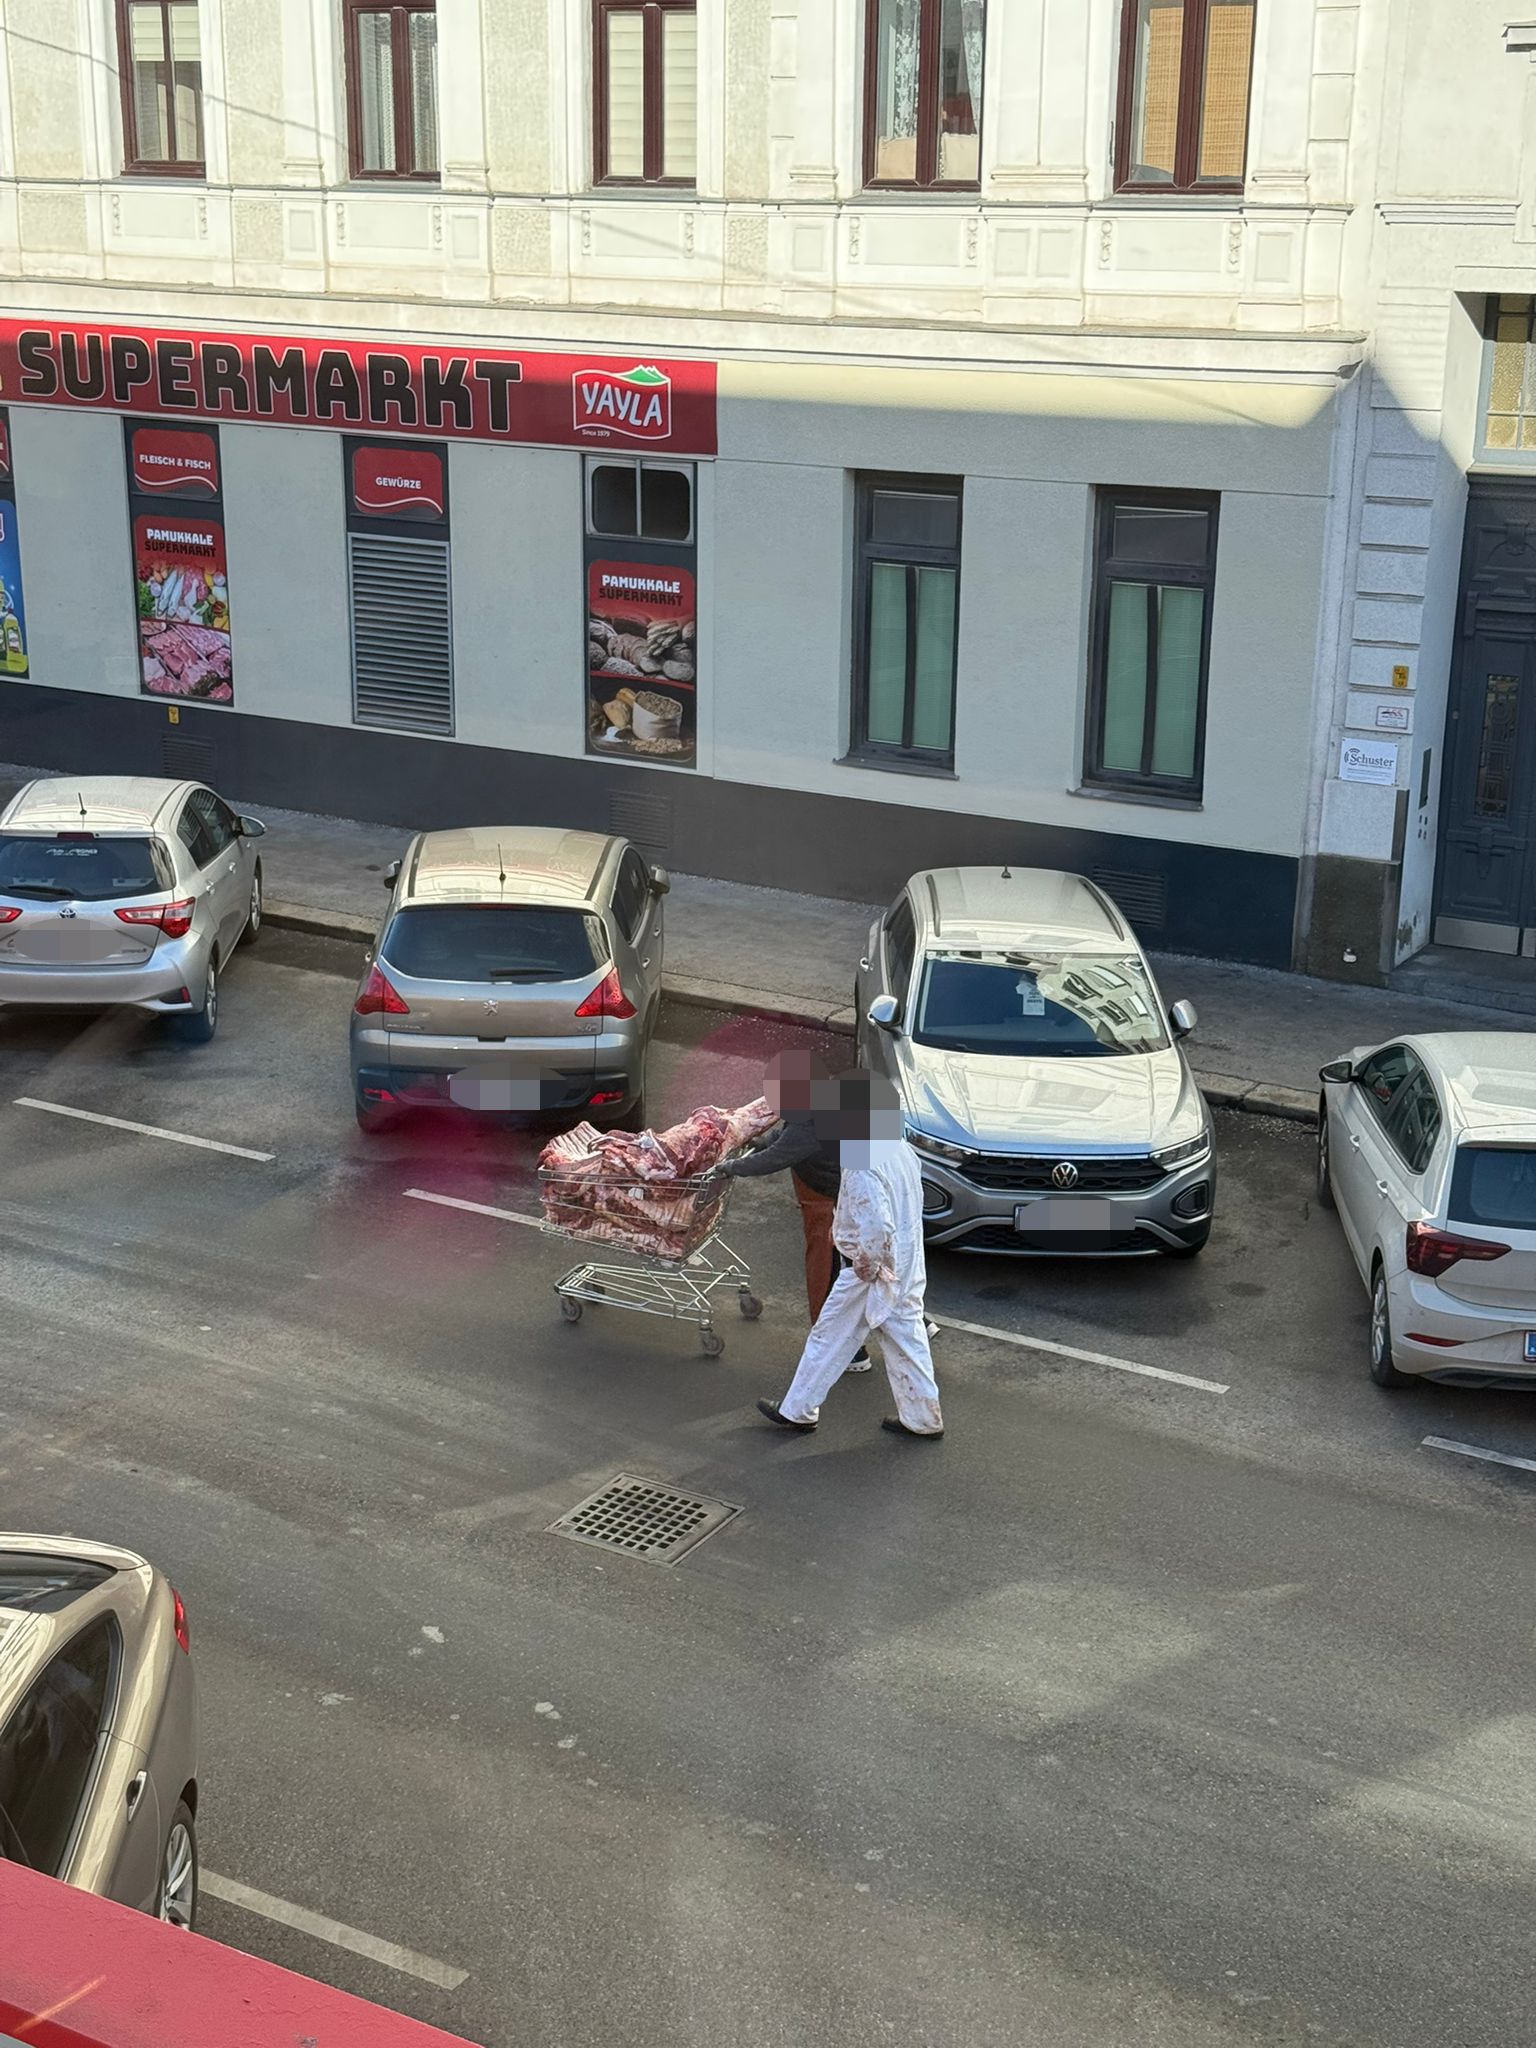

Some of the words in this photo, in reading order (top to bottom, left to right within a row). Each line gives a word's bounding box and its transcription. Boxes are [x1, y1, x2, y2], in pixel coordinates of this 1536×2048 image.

[18, 329, 523, 433] SUPERMARKT
[582, 381, 663, 427] YAYLA
[139, 454, 175, 466] FLEISCH
[176, 458, 183, 467] &
[185, 459, 212, 470] FISCH
[375, 476, 422, 490] GEWÜRZE
[146, 528, 214, 545] PAMUKKALE
[144, 541, 217, 557] SUPERMARKT
[602, 574, 681, 593] PAMUKKALE
[599, 588, 684, 607] SUPERMARKT
[1350, 753, 1395, 767] Schuster
